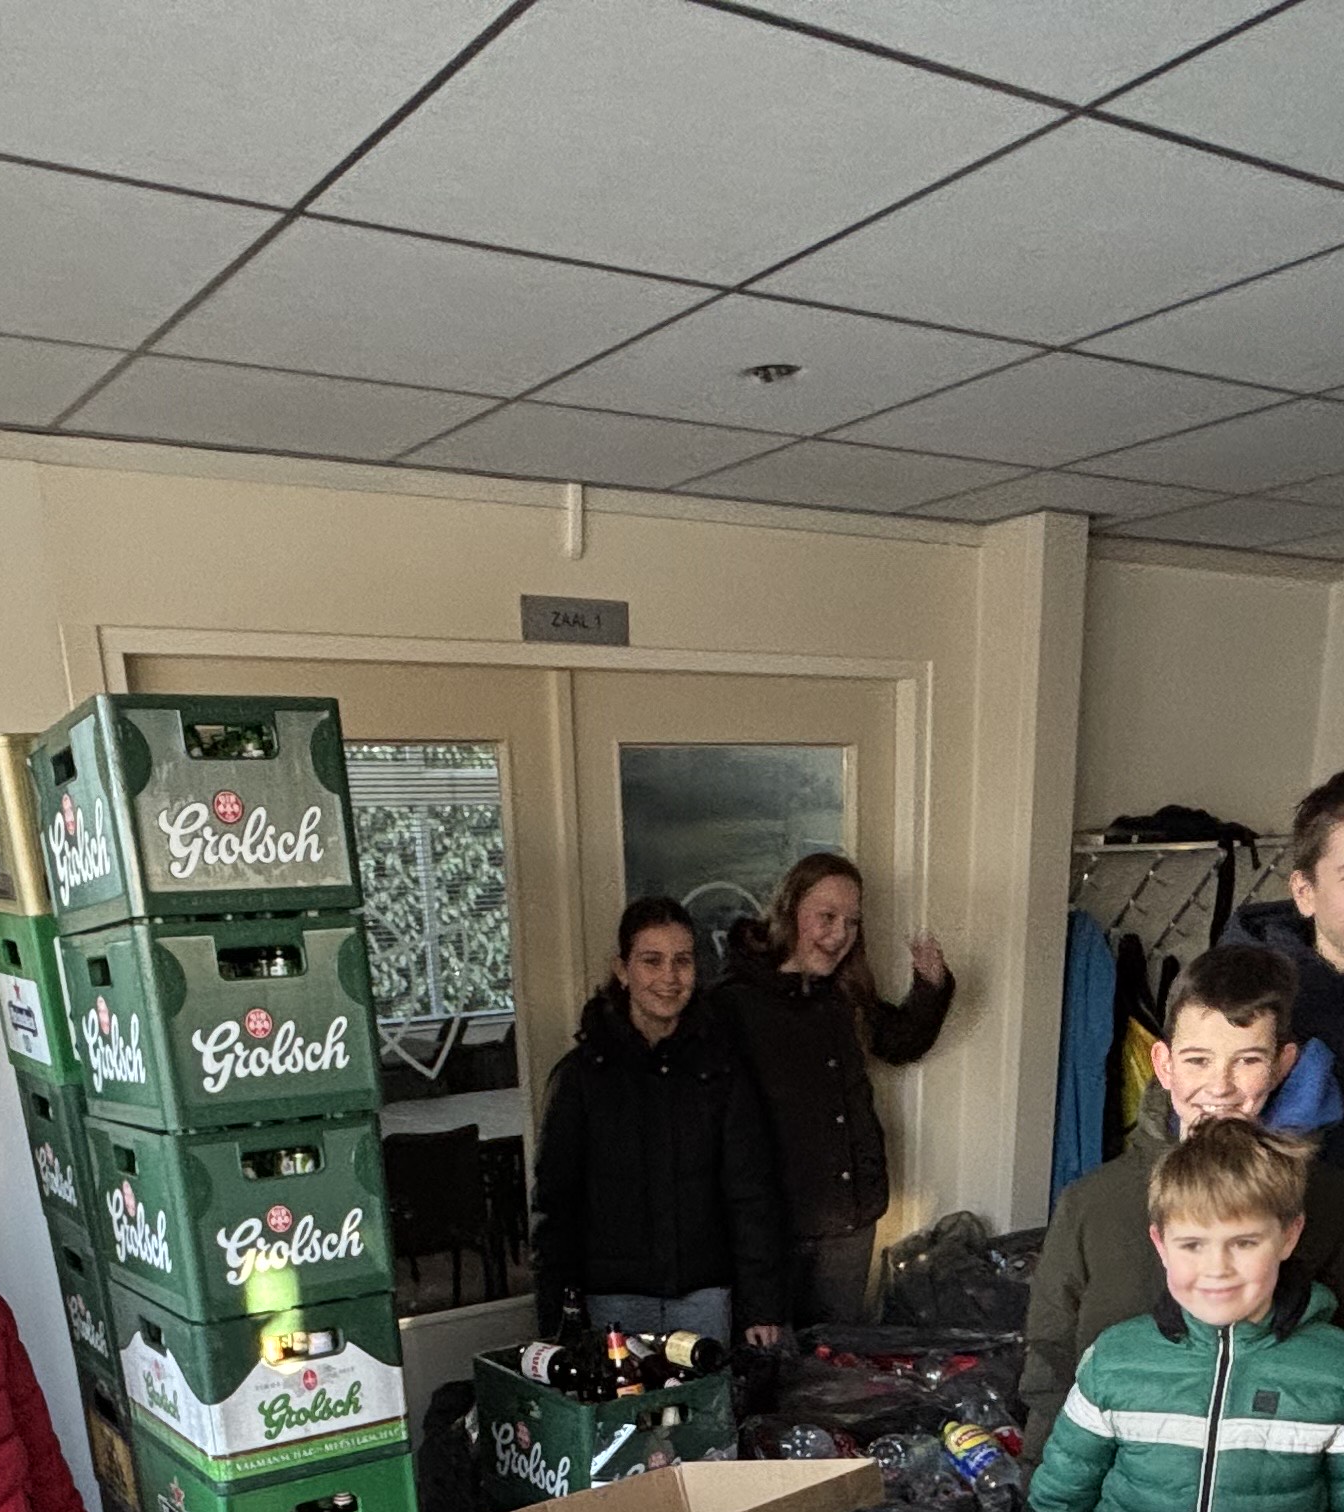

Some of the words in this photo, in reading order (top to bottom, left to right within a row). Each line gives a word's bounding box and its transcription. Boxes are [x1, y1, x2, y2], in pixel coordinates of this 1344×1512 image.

[550, 610, 589, 629] ZAAL
[49, 798, 111, 906] Grolsch
[158, 802, 325, 879] Grolsch
[81, 1007, 147, 1093] Grolsch
[191, 1015, 351, 1094] Grolsch
[107, 1187, 172, 1273] Grolsch
[216, 1207, 365, 1285] Grolsch
[258, 1380, 364, 1440] Grolsch
[491, 1420, 571, 1498] Grolsch
